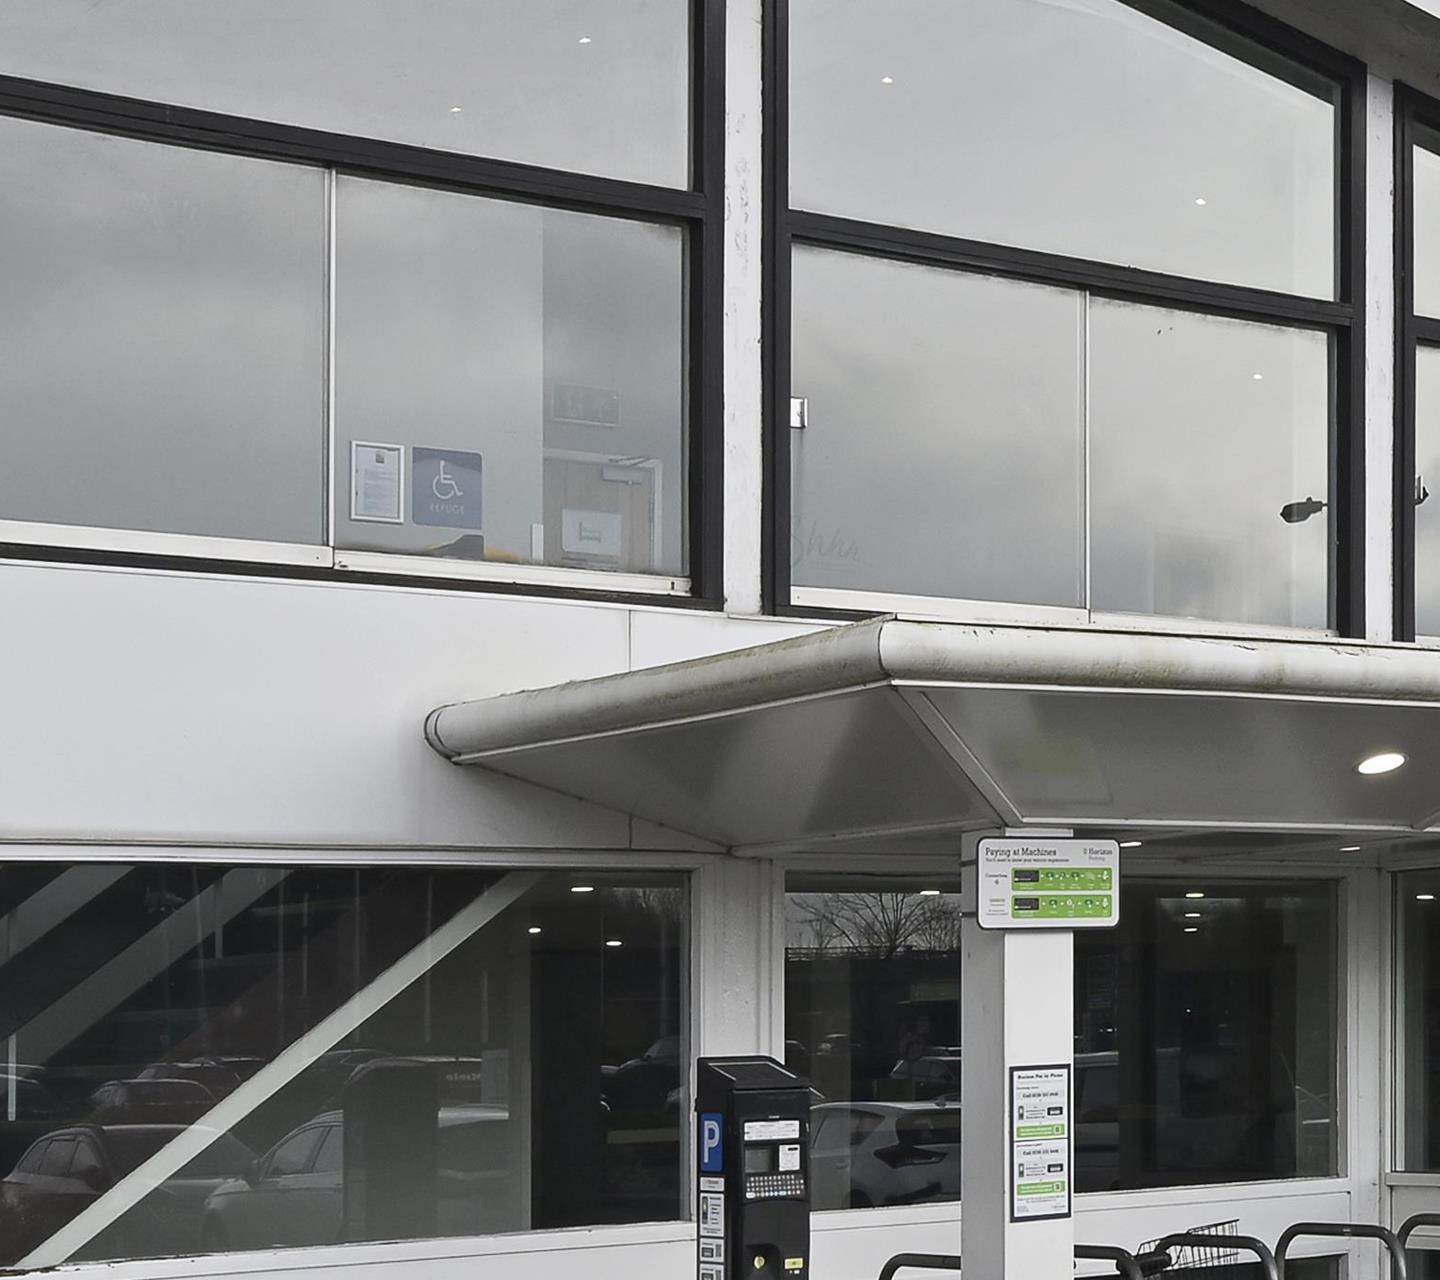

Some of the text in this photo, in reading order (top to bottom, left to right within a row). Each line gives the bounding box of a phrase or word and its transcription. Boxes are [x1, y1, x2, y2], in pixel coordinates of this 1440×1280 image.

[985, 847, 1011, 858] Paying
[1021, 847, 1057, 856] Machines
[704, 1120, 720, 1164] P
